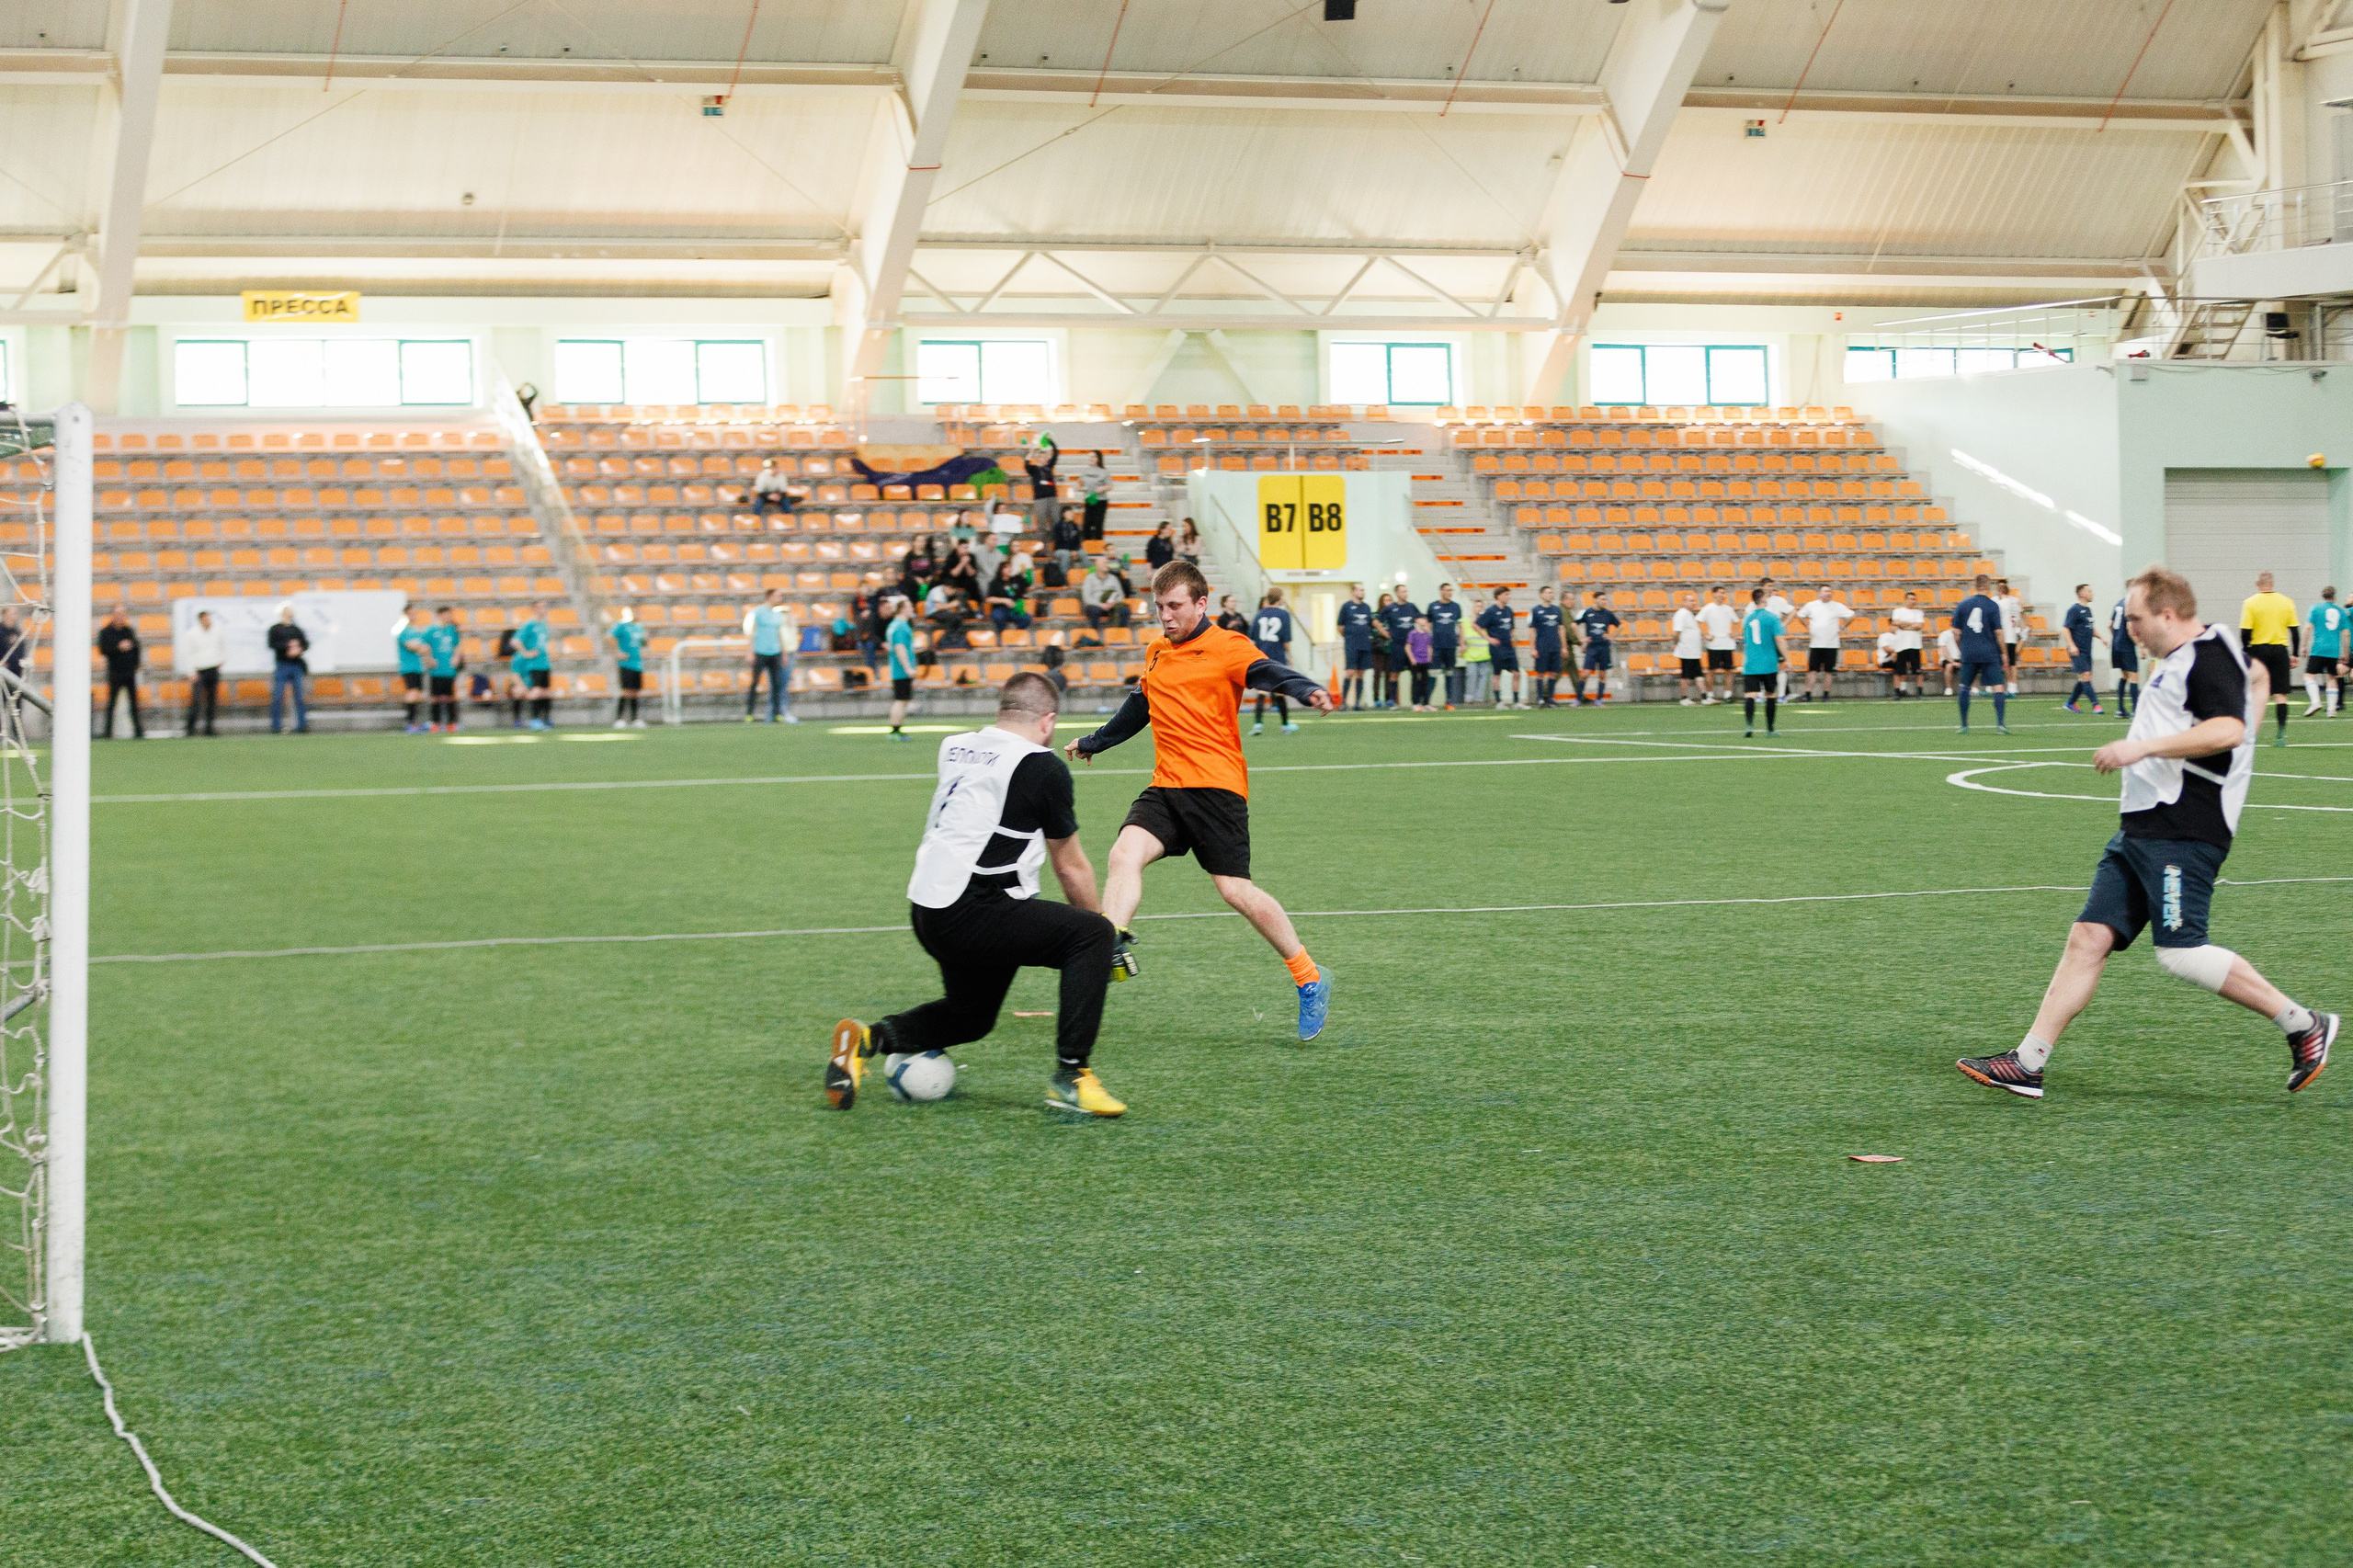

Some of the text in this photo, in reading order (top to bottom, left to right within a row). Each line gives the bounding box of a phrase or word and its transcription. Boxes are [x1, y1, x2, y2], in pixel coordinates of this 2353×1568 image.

[253, 300, 349, 314] ПРЕССА
[1266, 503, 1296, 533] B7
[1309, 503, 1342, 532] B8
[1257, 616, 1282, 642] 12
[1748, 619, 1762, 645] 1
[1967, 607, 1984, 634] 4
[2325, 608, 2340, 631] 9
[1149, 650, 1161, 672] 5
